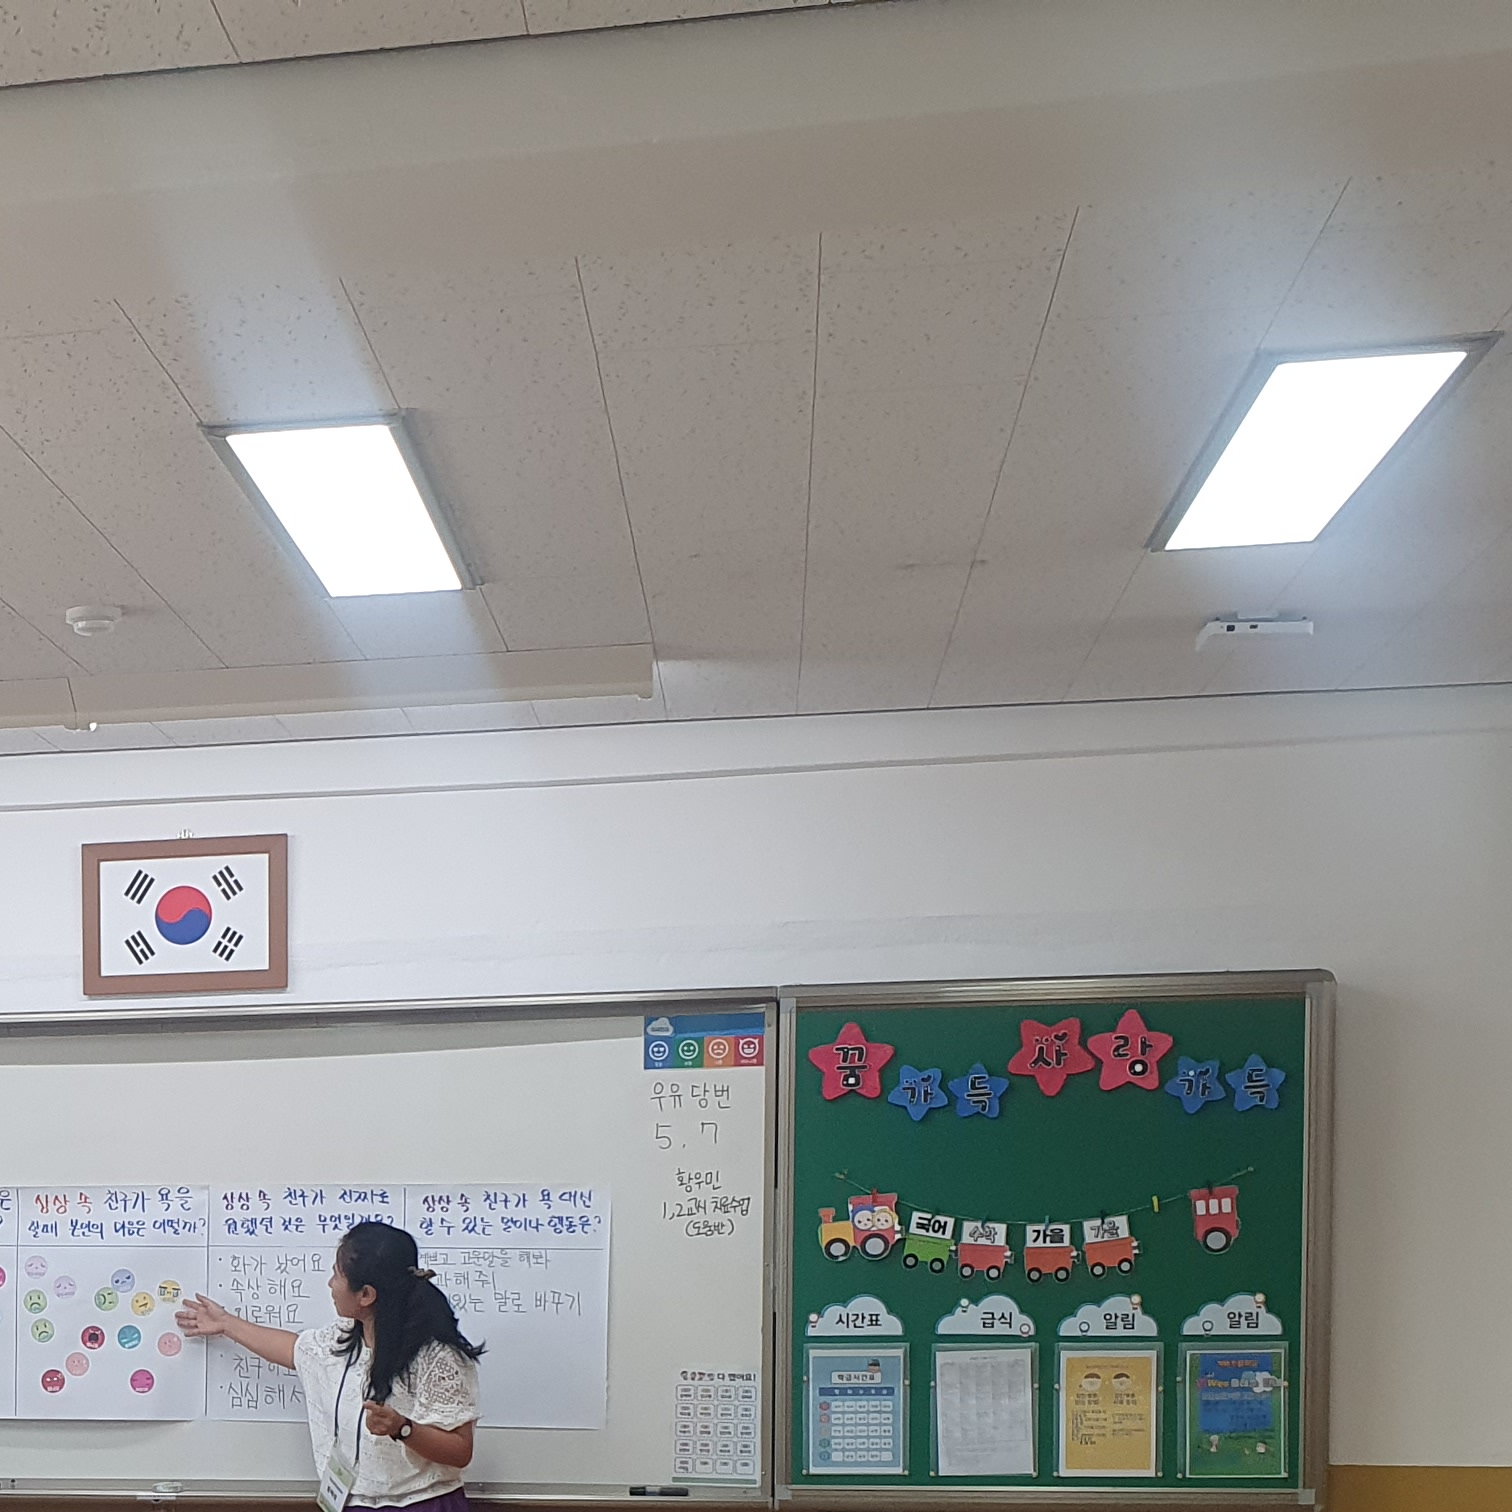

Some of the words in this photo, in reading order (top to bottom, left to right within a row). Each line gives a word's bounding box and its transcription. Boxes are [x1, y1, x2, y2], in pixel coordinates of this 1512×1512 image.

[834, 1045, 868, 1089] 꿈
[650, 1082, 683, 1112] 우유
[690, 1083, 732, 1109] 당번
[675, 1167, 722, 1193] 황우민
[104, 1189, 151, 1213] 친구가
[158, 1186, 194, 1212] 욕을
[222, 1190, 251, 1211] 상상
[258, 1189, 272, 1212] 속
[283, 1187, 327, 1208] 친구가
[422, 1194, 453, 1213] 상상
[457, 1193, 471, 1213] 속
[483, 1190, 529, 1211] 친구가
[538, 1188, 554, 1210] 욕
[558, 1189, 593, 1209] 대신
[152, 1217, 207, 1237] 어떨까?
[419, 1216, 435, 1236] 할
[439, 1216, 456, 1236] 수
[461, 1216, 494, 1237] 있는
[915, 1215, 949, 1236] 국어
[1031, 1227, 1065, 1244] 가을
[230, 1254, 267, 1275] 화가
[275, 1253, 326, 1275] 났어요
[493, 1290, 527, 1313] 말로
[835, 1312, 882, 1329] 시간표
[980, 1312, 1013, 1329] 급식
[1103, 1312, 1136, 1330] 알림
[1227, 1311, 1259, 1329] 알림
